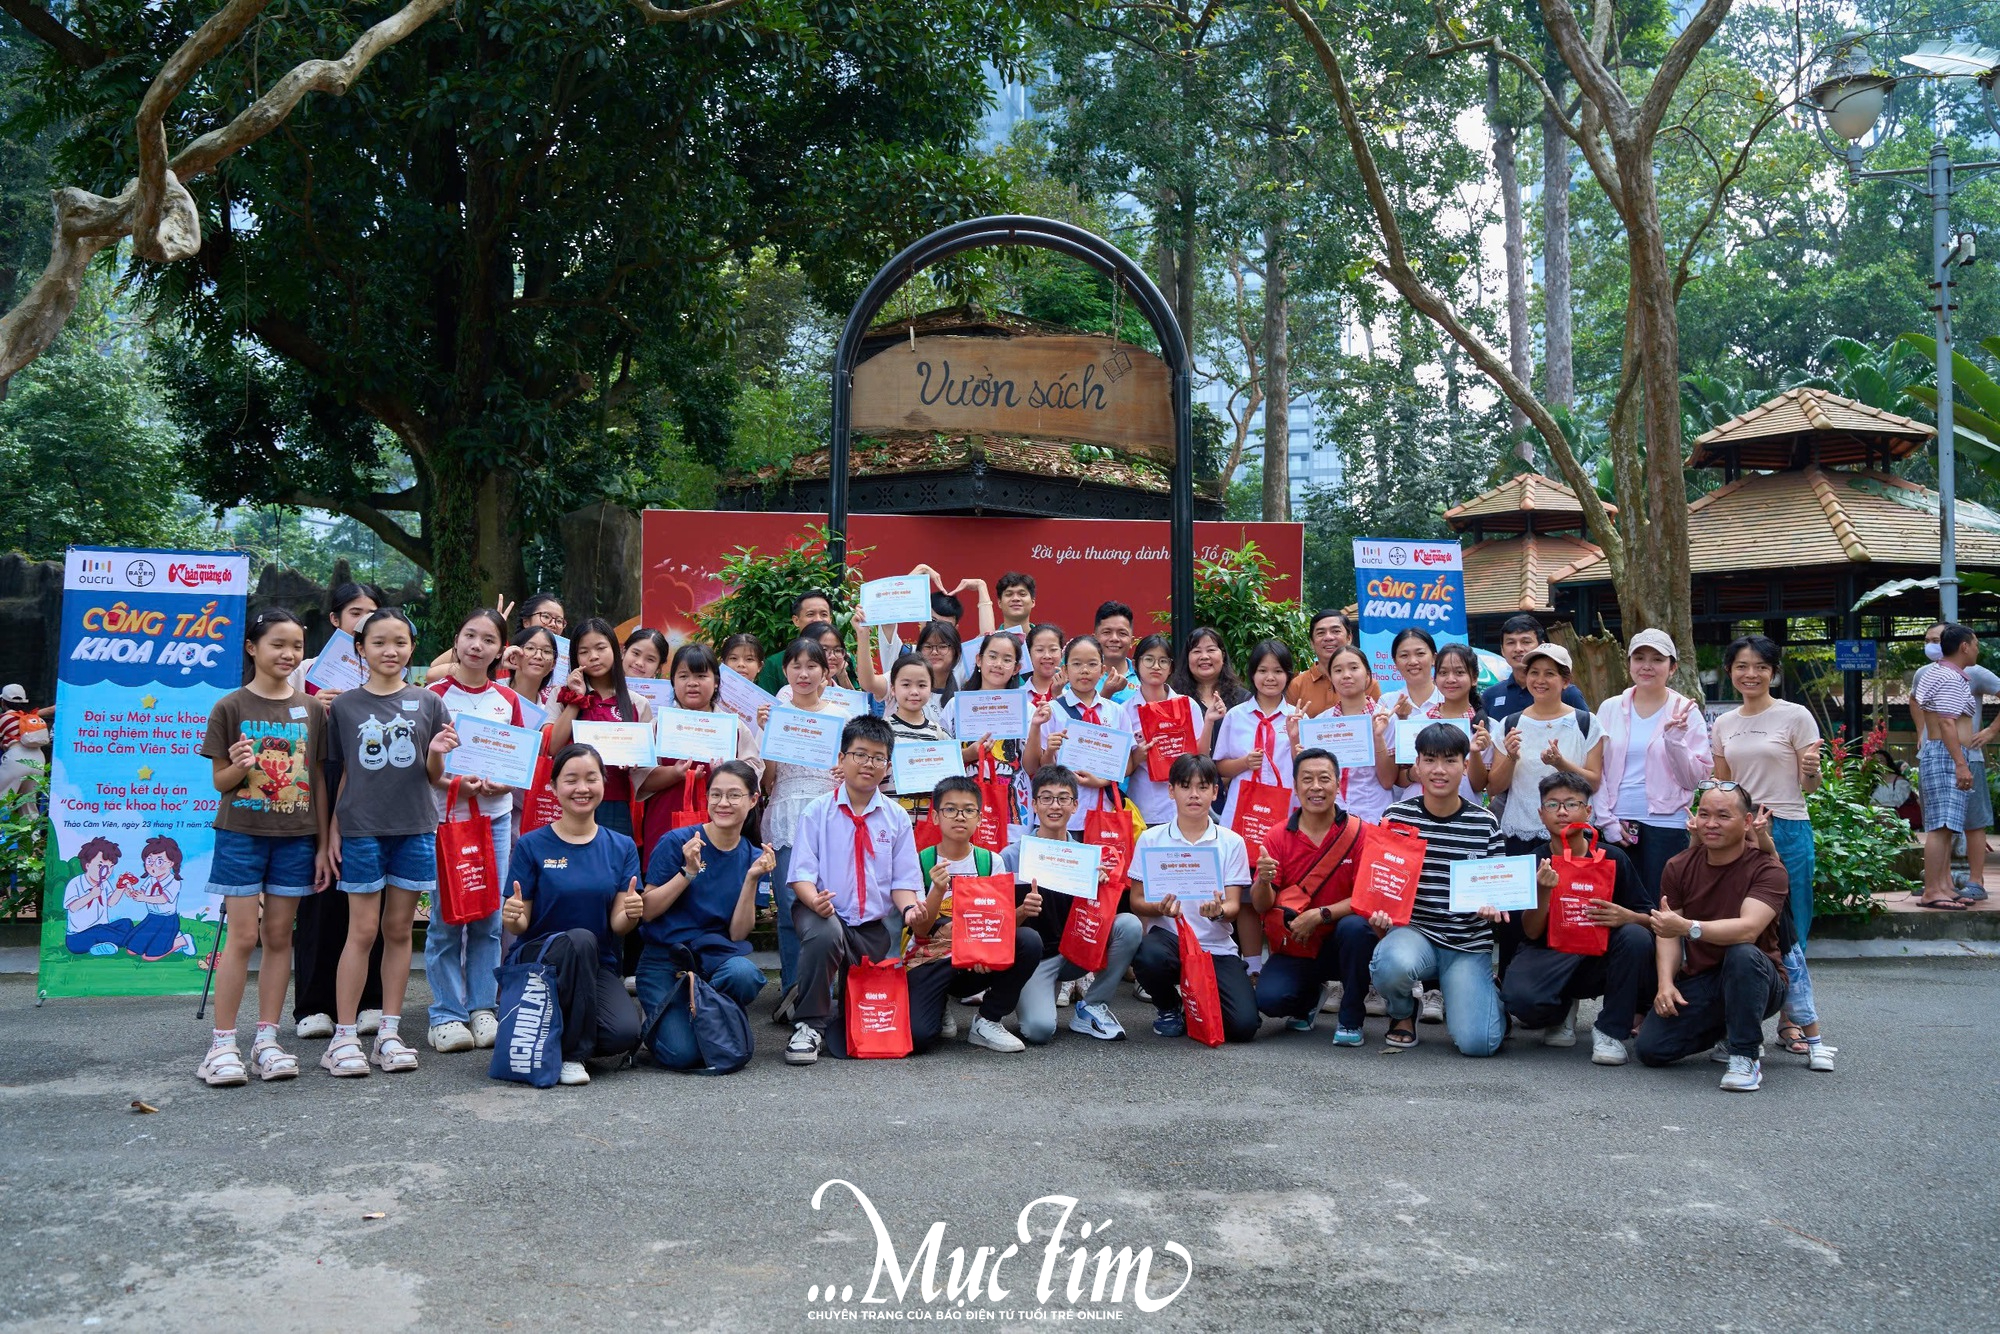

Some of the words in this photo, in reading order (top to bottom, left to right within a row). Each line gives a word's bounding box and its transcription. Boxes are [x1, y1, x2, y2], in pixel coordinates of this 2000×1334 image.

[917, 360, 1021, 407] Vườn
[1029, 364, 1106, 410] sách
[1031, 544, 1054, 559] Lời
[1056, 546, 1082, 564] yêu
[1084, 546, 1132, 565] thương
[1135, 546, 1171, 560] dành
[78, 574, 113, 584] oucru
[1367, 575, 1416, 600] CÔNG
[1421, 575, 1456, 602] TẮC
[82, 601, 167, 636] CÔNG
[173, 601, 232, 640] TẮC
[1363, 600, 1411, 618] KHOA
[1413, 603, 1453, 626] HỌC
[70, 637, 154, 664] KHOA
[156, 641, 226, 675] HỌC
[84, 710, 105, 724] Đại
[127, 711, 151, 724] Một
[154, 712, 173, 723] sức
[178, 713, 206, 723] khỏe
[78, 726, 99, 738] trải
[104, 727, 148, 741] nghiệm
[153, 727, 177, 741] thực
[182, 727, 192, 738] tế
[73, 742, 103, 753] Thảo
[107, 742, 135, 754] Cầm
[140, 743, 166, 754] Viên
[171, 743, 189, 754] Sài
[96, 783, 126, 797] Tổng
[131, 783, 148, 794] kết
[153, 783, 168, 797] dự
[172, 785, 187, 794] án
[104, 800, 121, 811] tắc
[126, 800, 156, 811] khoa
[64, 820, 81, 828] Thảo
[102, 821, 119, 829] Viên,
[122, 822, 140, 830] ngày
[153, 821, 173, 830] tháng
[510, 972, 546, 1073] HCMULAW
